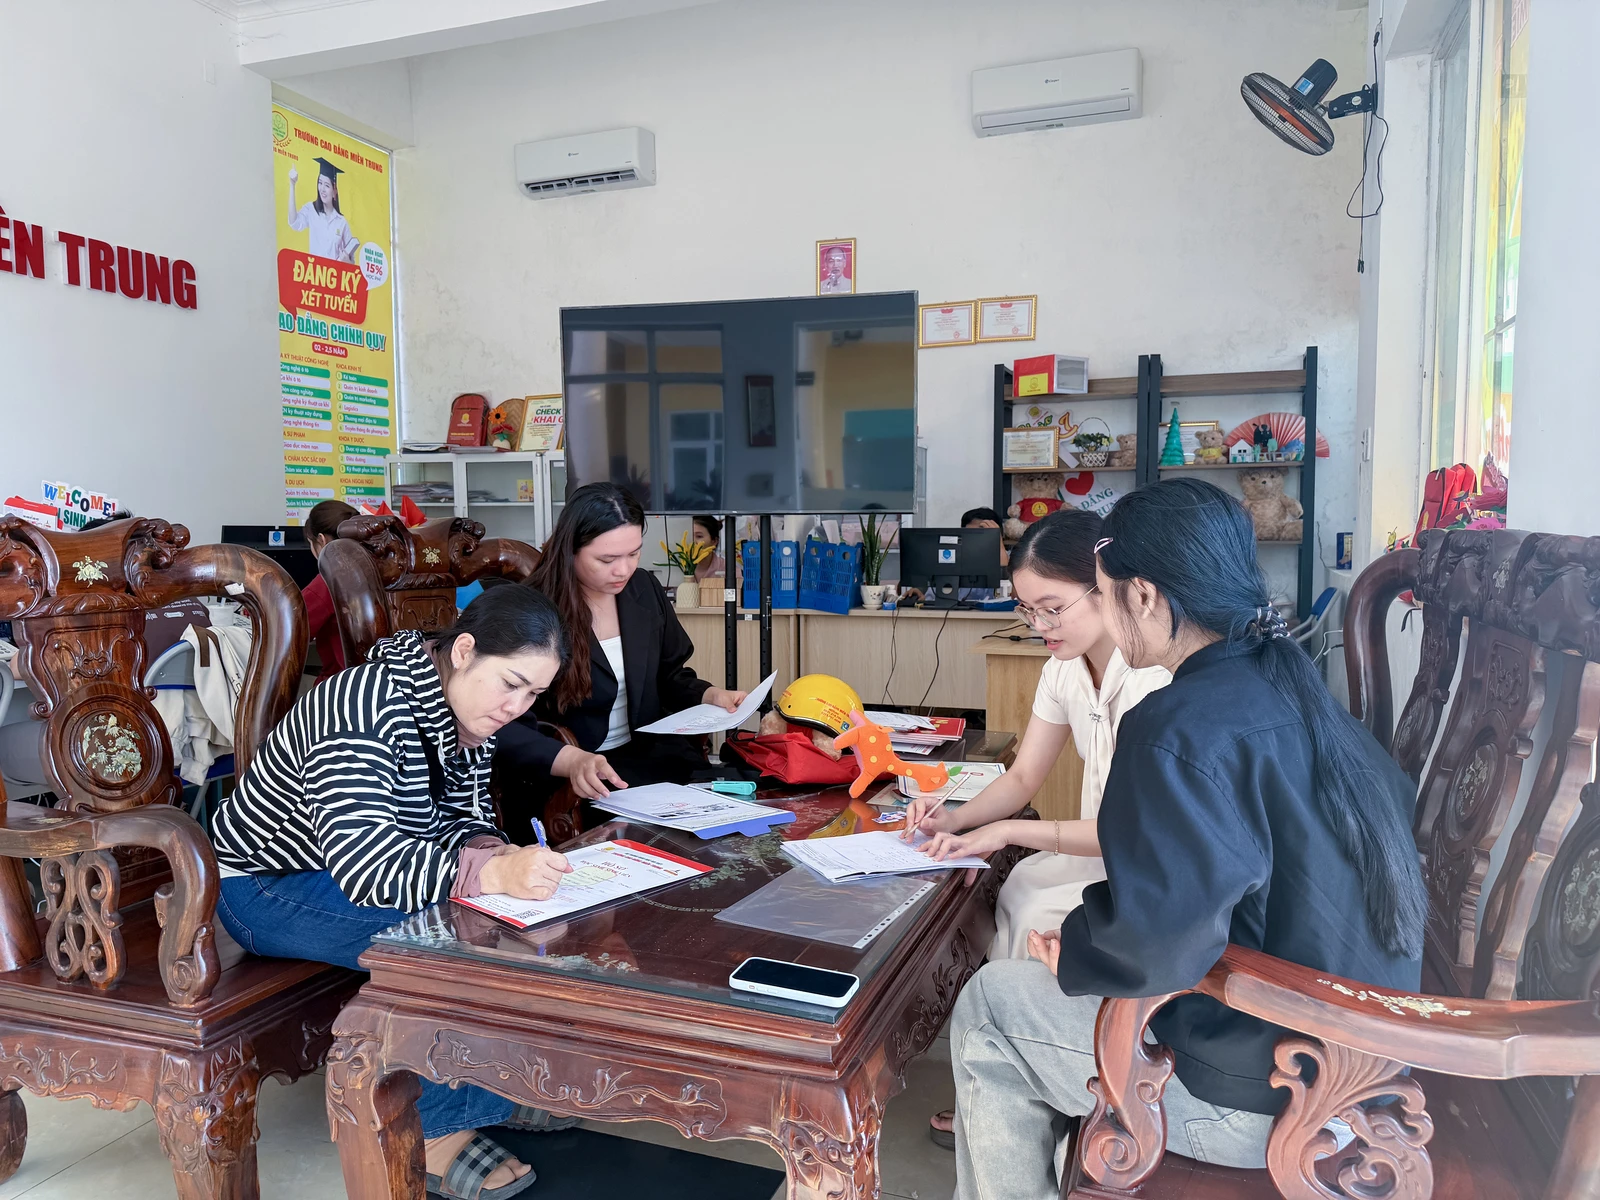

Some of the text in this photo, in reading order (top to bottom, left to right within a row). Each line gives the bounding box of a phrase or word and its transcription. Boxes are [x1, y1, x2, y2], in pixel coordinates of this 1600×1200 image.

[294, 128, 318, 146] TRƯỜNG
[320, 139, 332, 152] CAO
[350, 152, 364, 166] MIỀN
[365, 158, 382, 173] TRUNG
[58, 230, 197, 309] TRUNG
[293, 256, 361, 294] ĐĂNG KÝ
[366, 262, 383, 276] 15%
[301, 288, 357, 314] XÉT TUYỂN
[279, 312, 386, 351] AO ĐẲNG CHÍNH QUY
[333, 347, 345, 356] NĂM
[44, 484, 116, 516] WELCOME!
[63, 509, 86, 528] SINH
